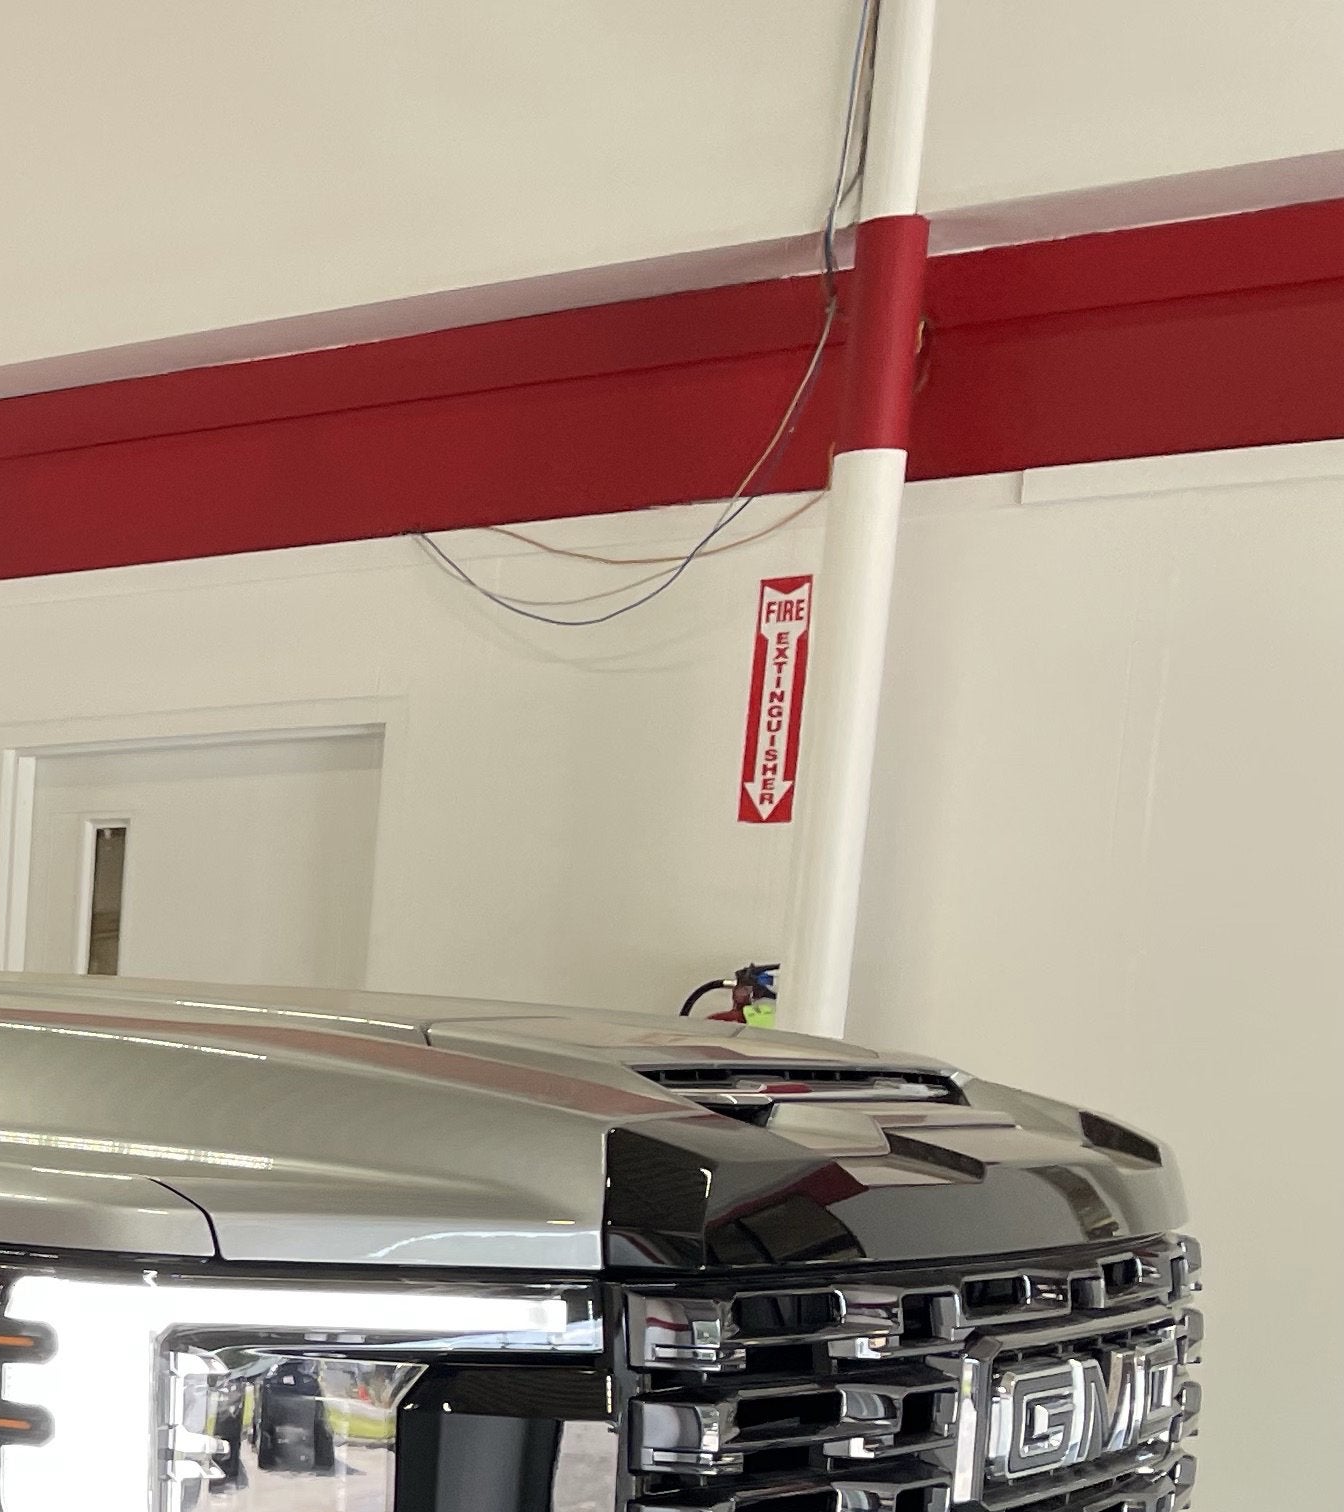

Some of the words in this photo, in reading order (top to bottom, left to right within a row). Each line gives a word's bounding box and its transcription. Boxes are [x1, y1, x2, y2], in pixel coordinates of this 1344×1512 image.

[765, 598, 805, 624] FIRE
[759, 631, 790, 805] EXTINGUISHER
[989, 1336, 1183, 1478] GMC
